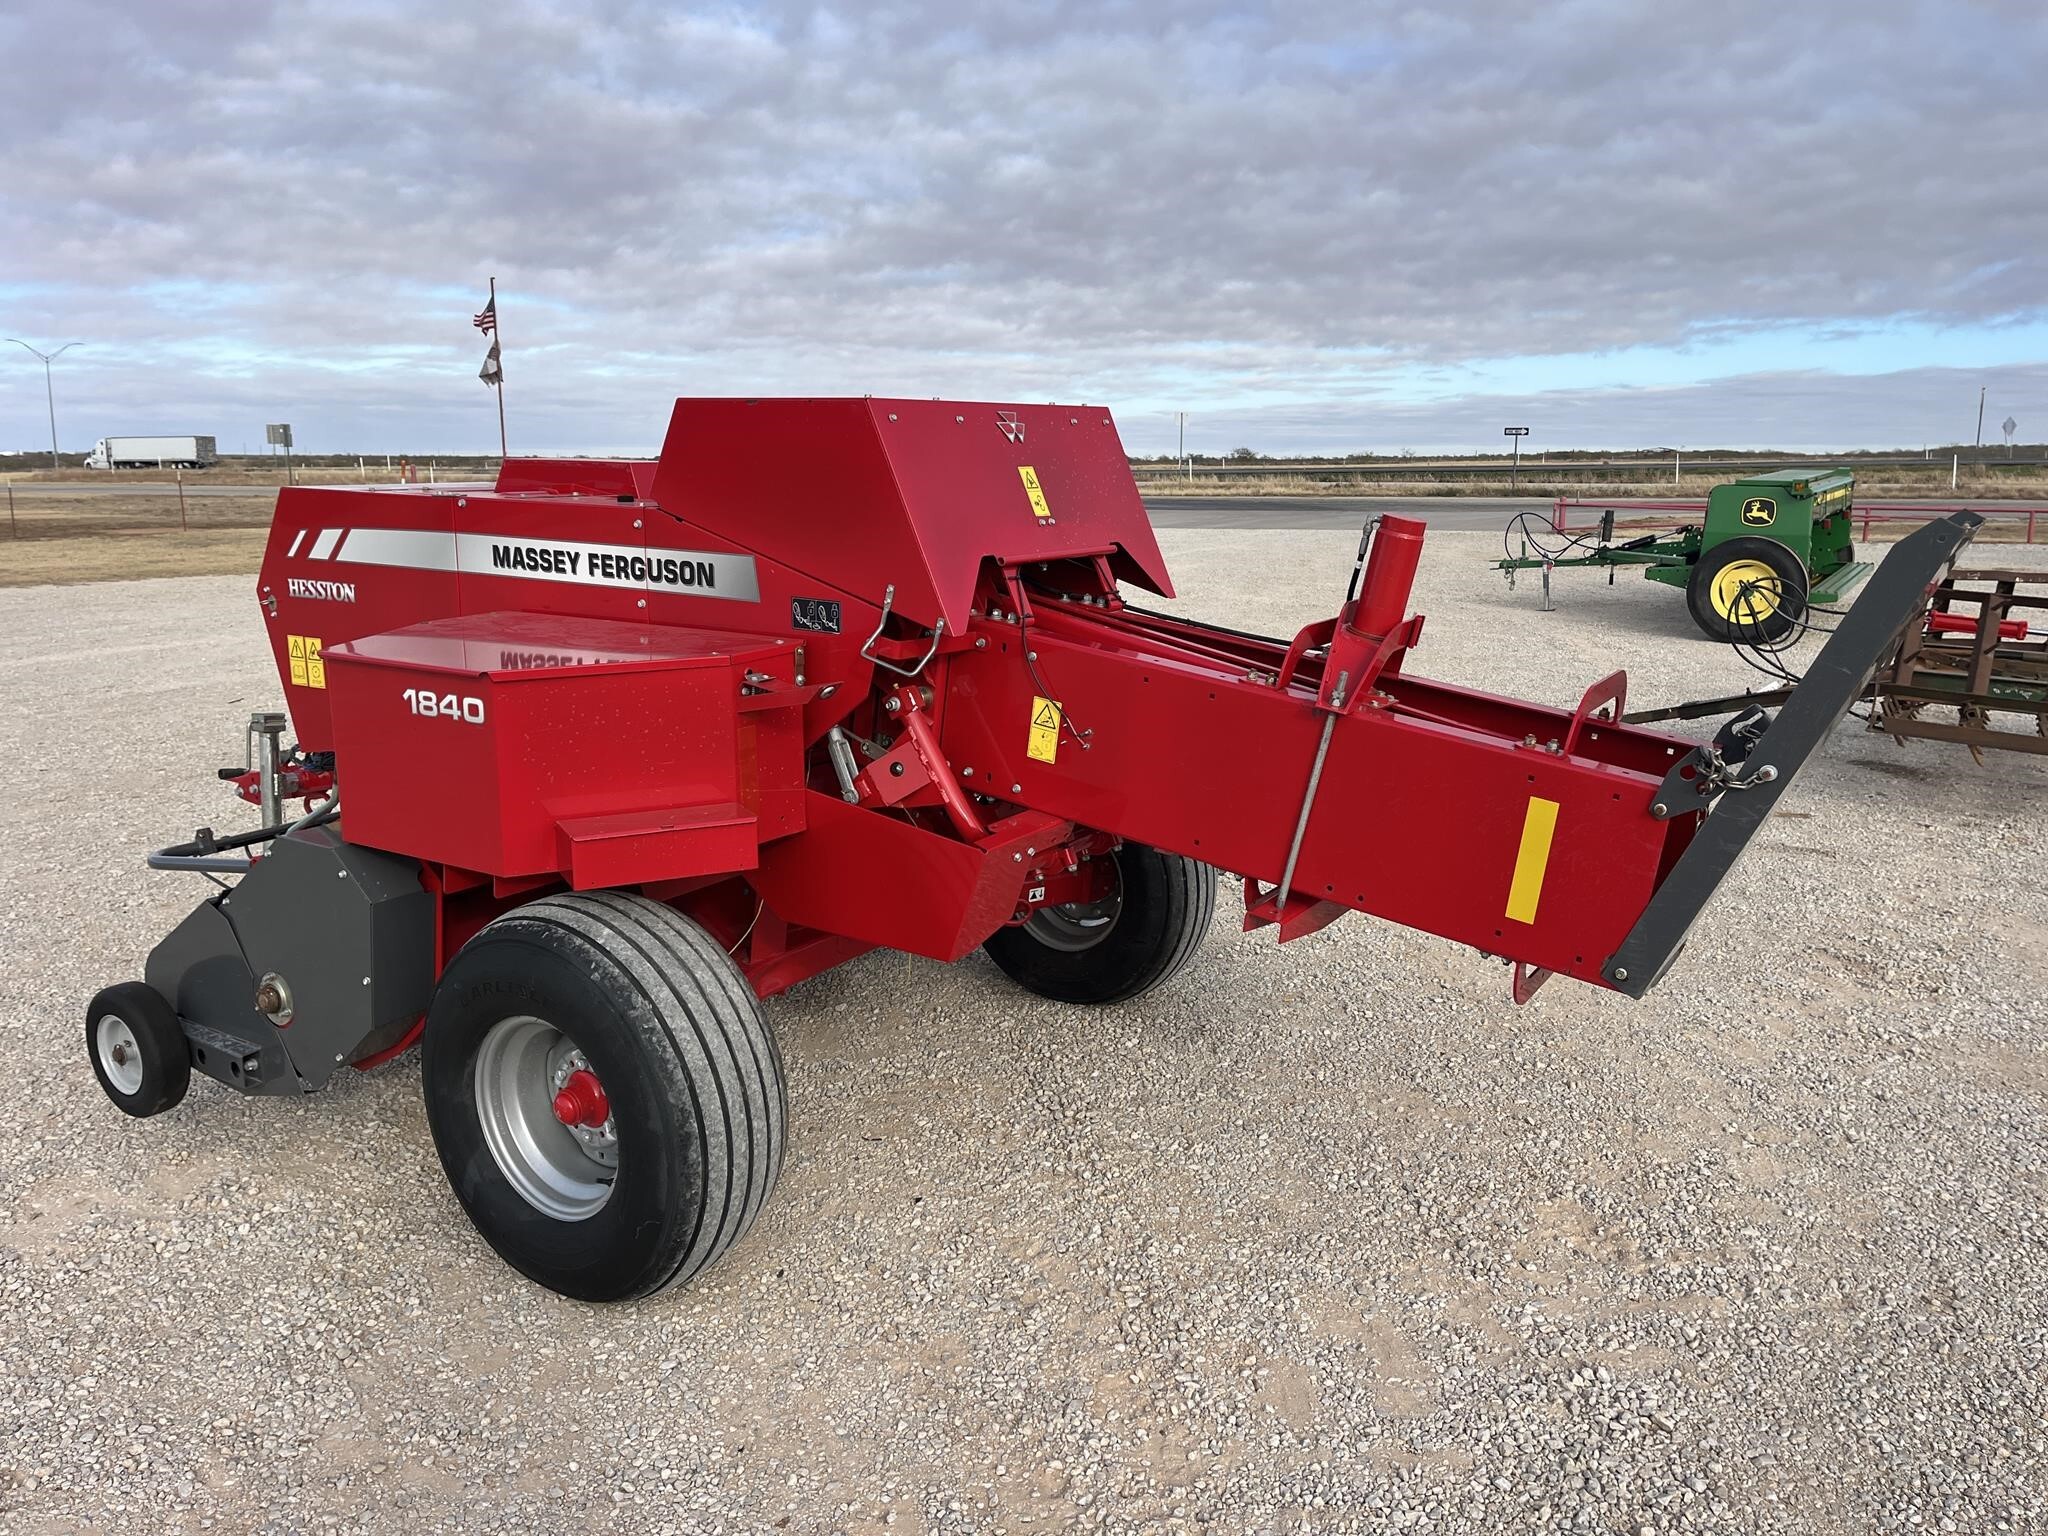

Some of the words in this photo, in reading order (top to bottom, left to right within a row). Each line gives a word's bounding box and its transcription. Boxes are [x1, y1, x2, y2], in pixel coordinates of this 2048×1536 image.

[492, 544, 581, 575] MASSEY
[588, 552, 716, 588] FERGUSON
[287, 578, 356, 603] HESSTON
[402, 688, 485, 724] 1840
